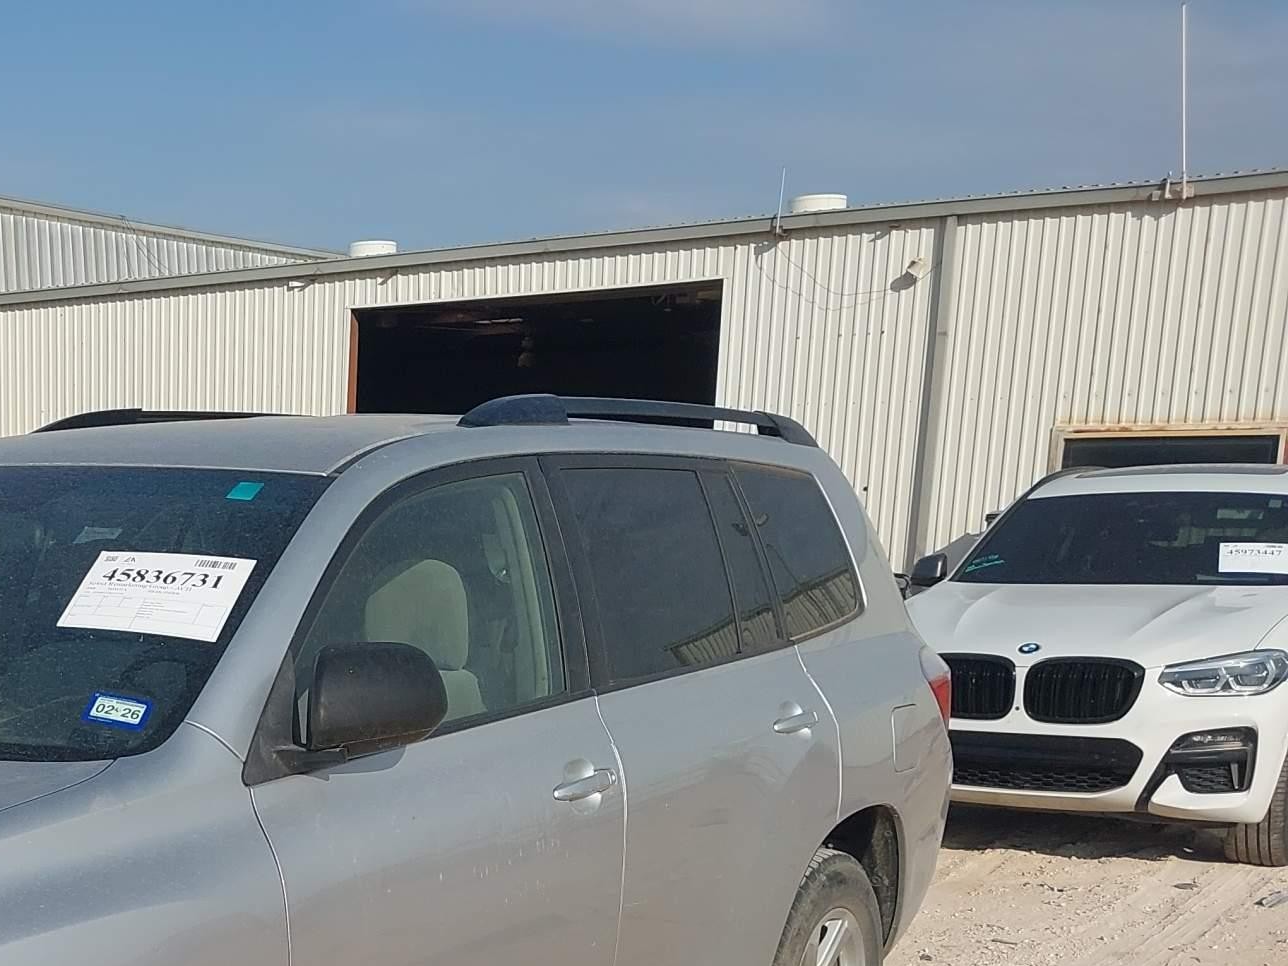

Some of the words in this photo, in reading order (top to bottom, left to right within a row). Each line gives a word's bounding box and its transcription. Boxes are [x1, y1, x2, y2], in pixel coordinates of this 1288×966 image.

[102, 567, 225, 590] 45836731
[95, 703, 115, 715] 02
[120, 707, 141, 720] 26
